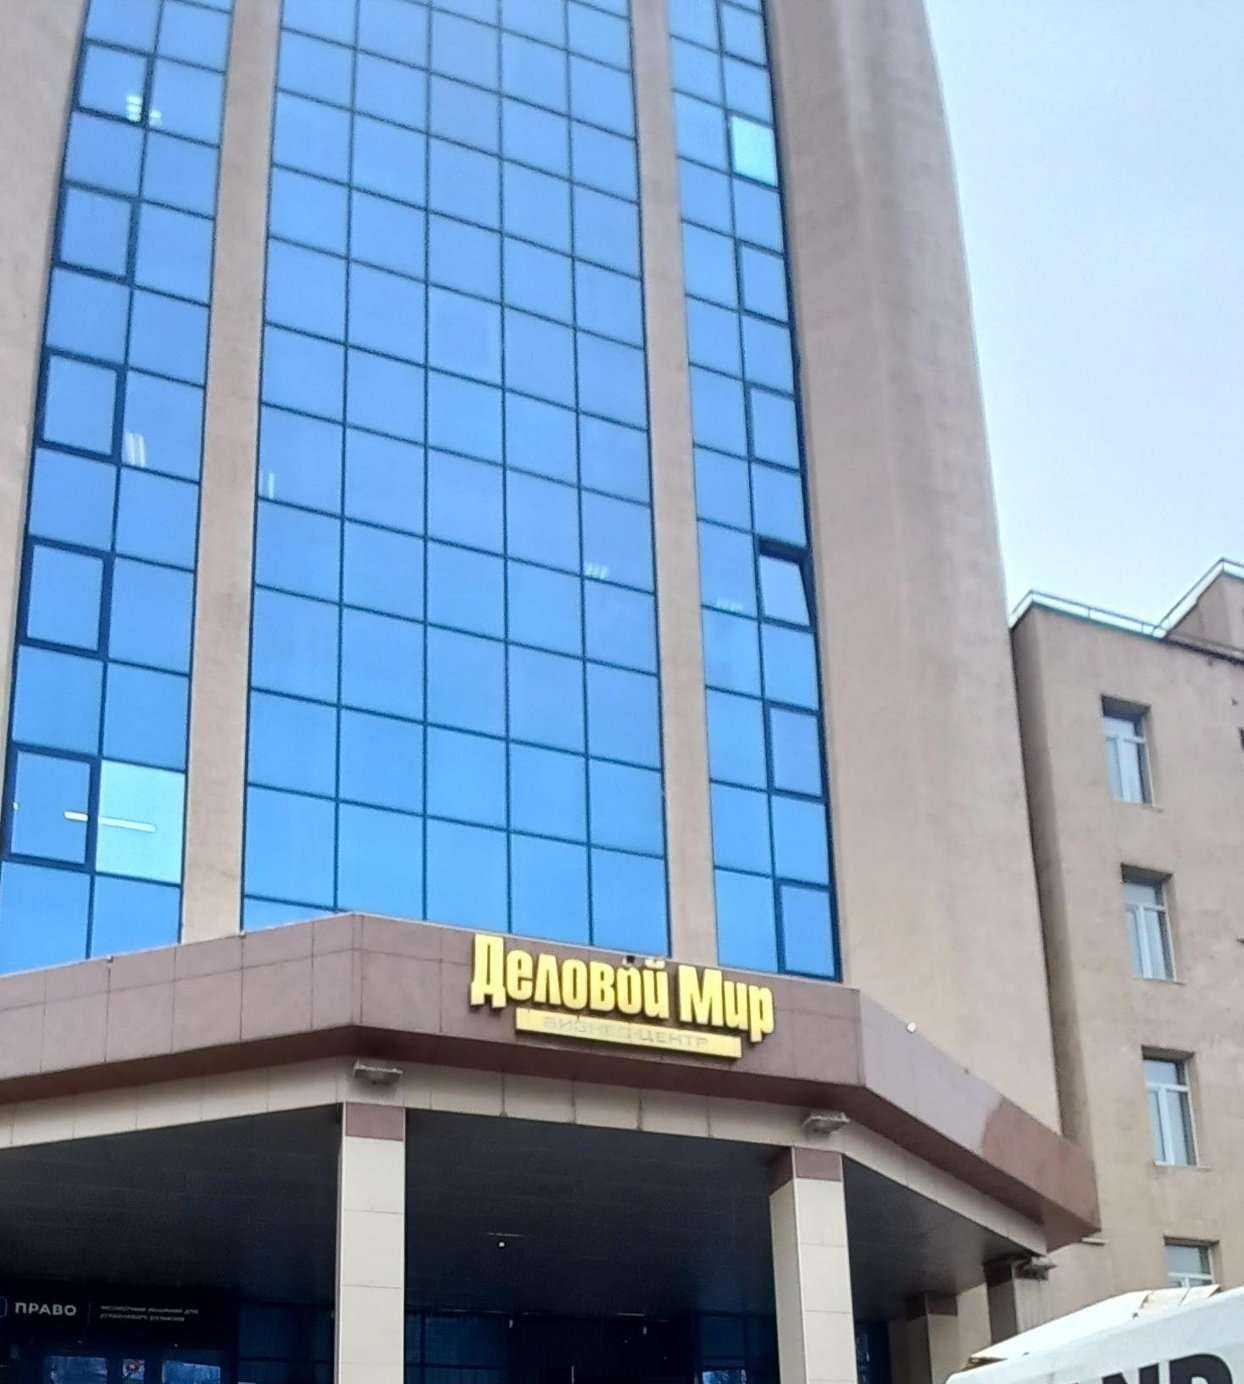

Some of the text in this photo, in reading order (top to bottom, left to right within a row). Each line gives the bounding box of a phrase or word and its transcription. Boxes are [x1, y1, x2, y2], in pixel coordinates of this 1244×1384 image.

[470, 934, 775, 1043] Деловой Мир
[15, 1302, 77, 1316] ПРАВО
